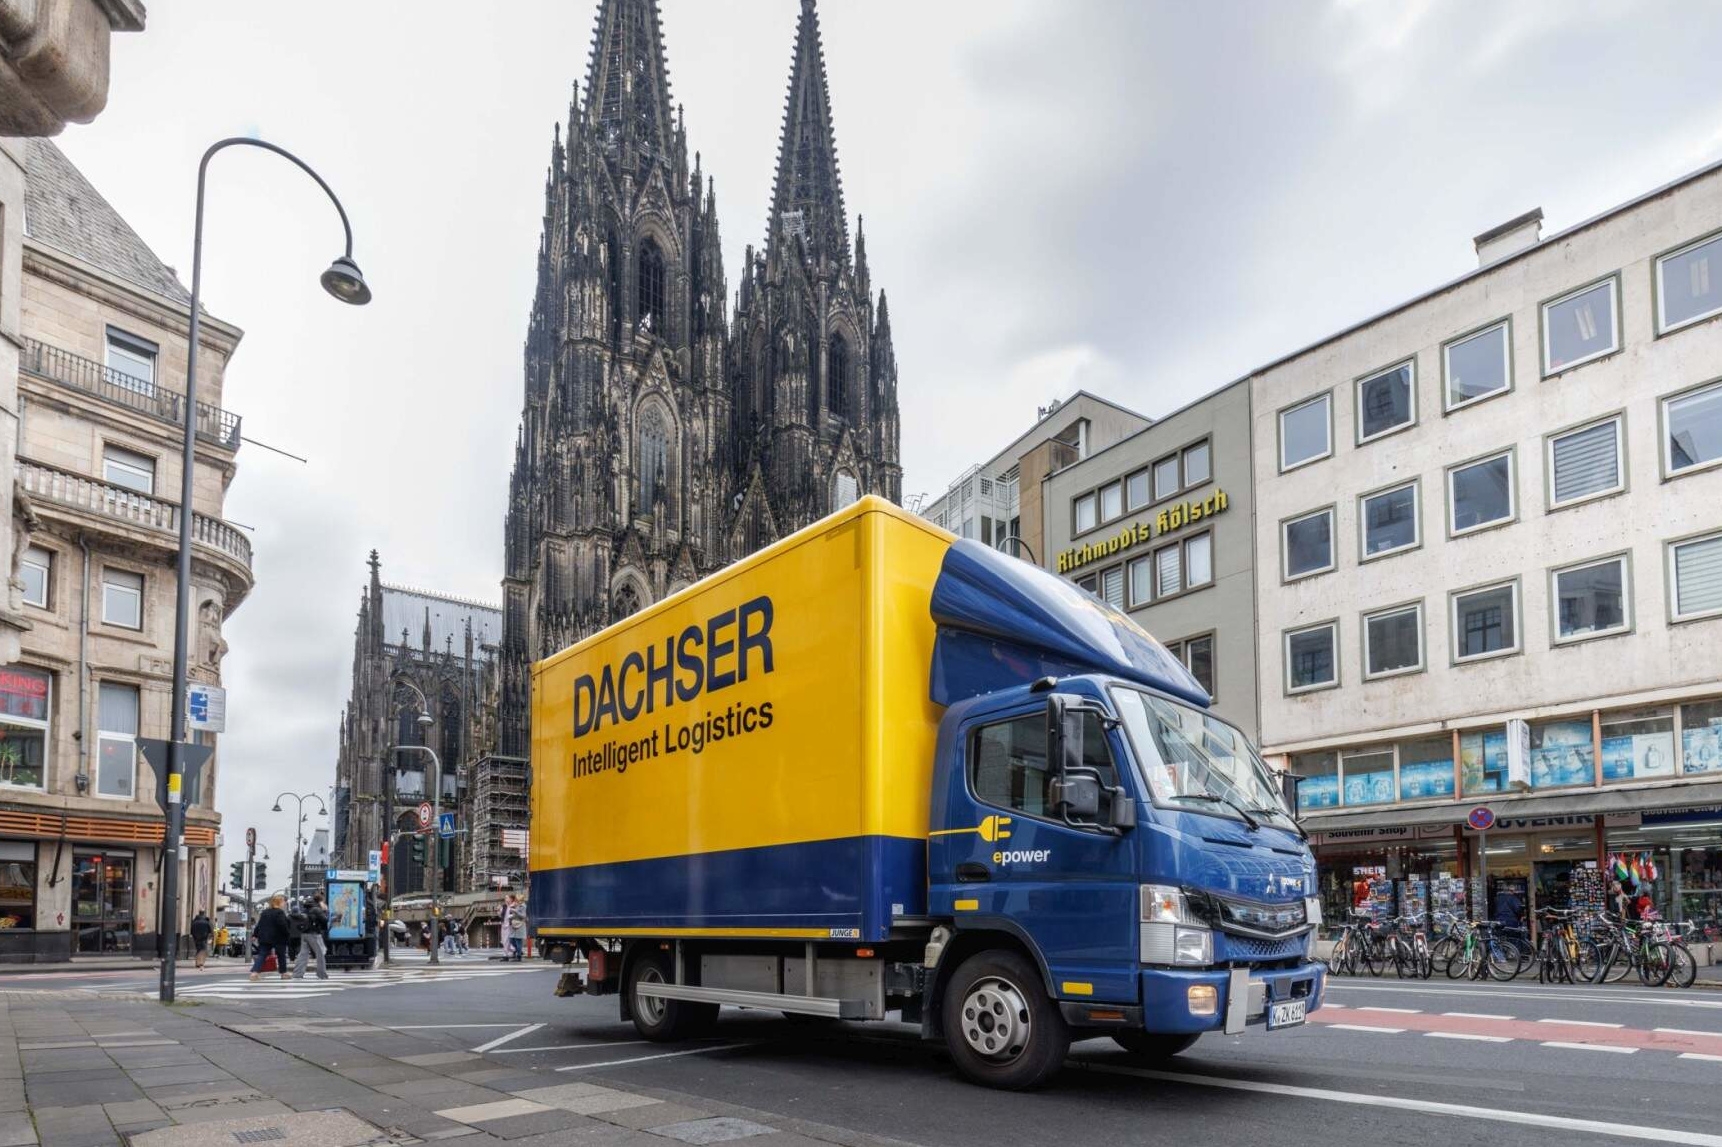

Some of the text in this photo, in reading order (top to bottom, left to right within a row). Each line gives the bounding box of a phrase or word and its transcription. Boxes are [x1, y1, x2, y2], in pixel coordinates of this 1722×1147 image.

[1056, 488, 1229, 574] Richmodis Kölsch
[573, 595, 774, 739] DACHSER
[573, 701, 773, 778] Intelligent Logistics
[993, 849, 1051, 866] epower
[831, 929, 853, 937] JUNGE
